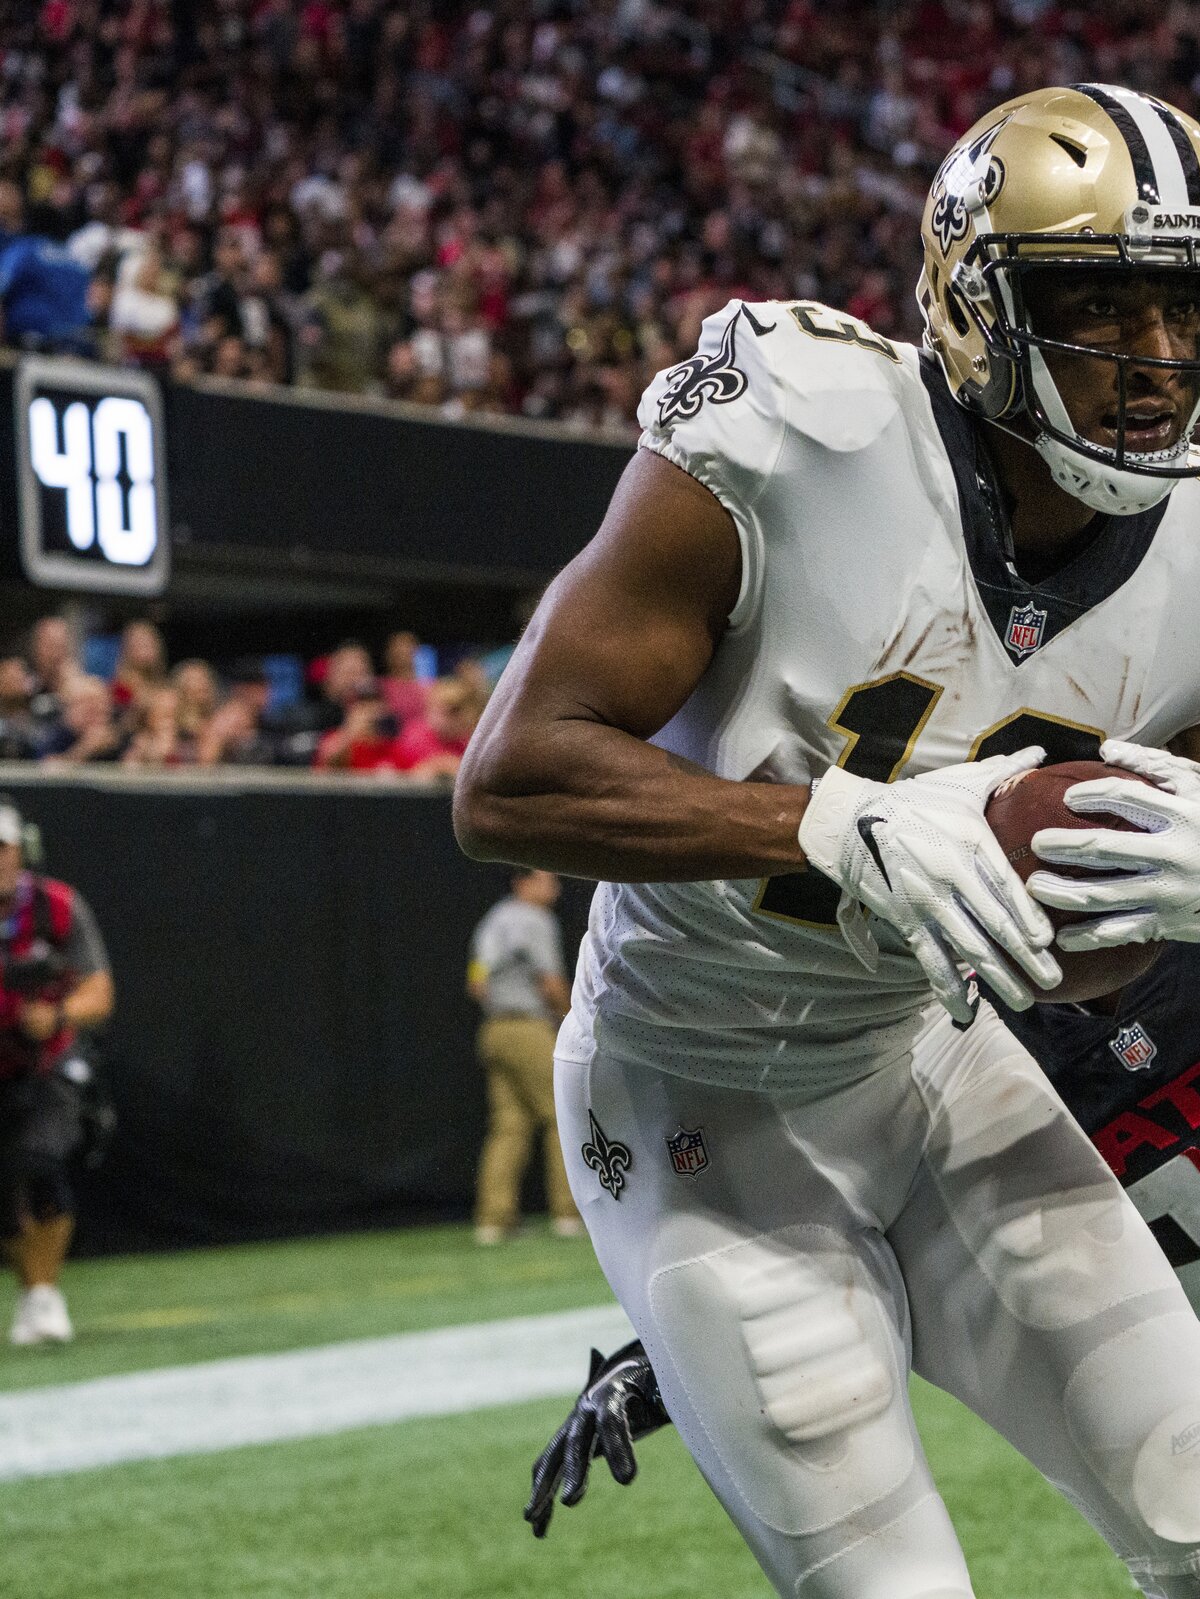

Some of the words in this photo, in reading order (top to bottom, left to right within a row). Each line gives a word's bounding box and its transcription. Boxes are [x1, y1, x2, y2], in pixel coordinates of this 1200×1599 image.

[29, 397, 157, 566] 40
[1010, 624, 1037, 648] NFL
[1122, 1040, 1152, 1066] NFL
[673, 1147, 706, 1171] NFL
